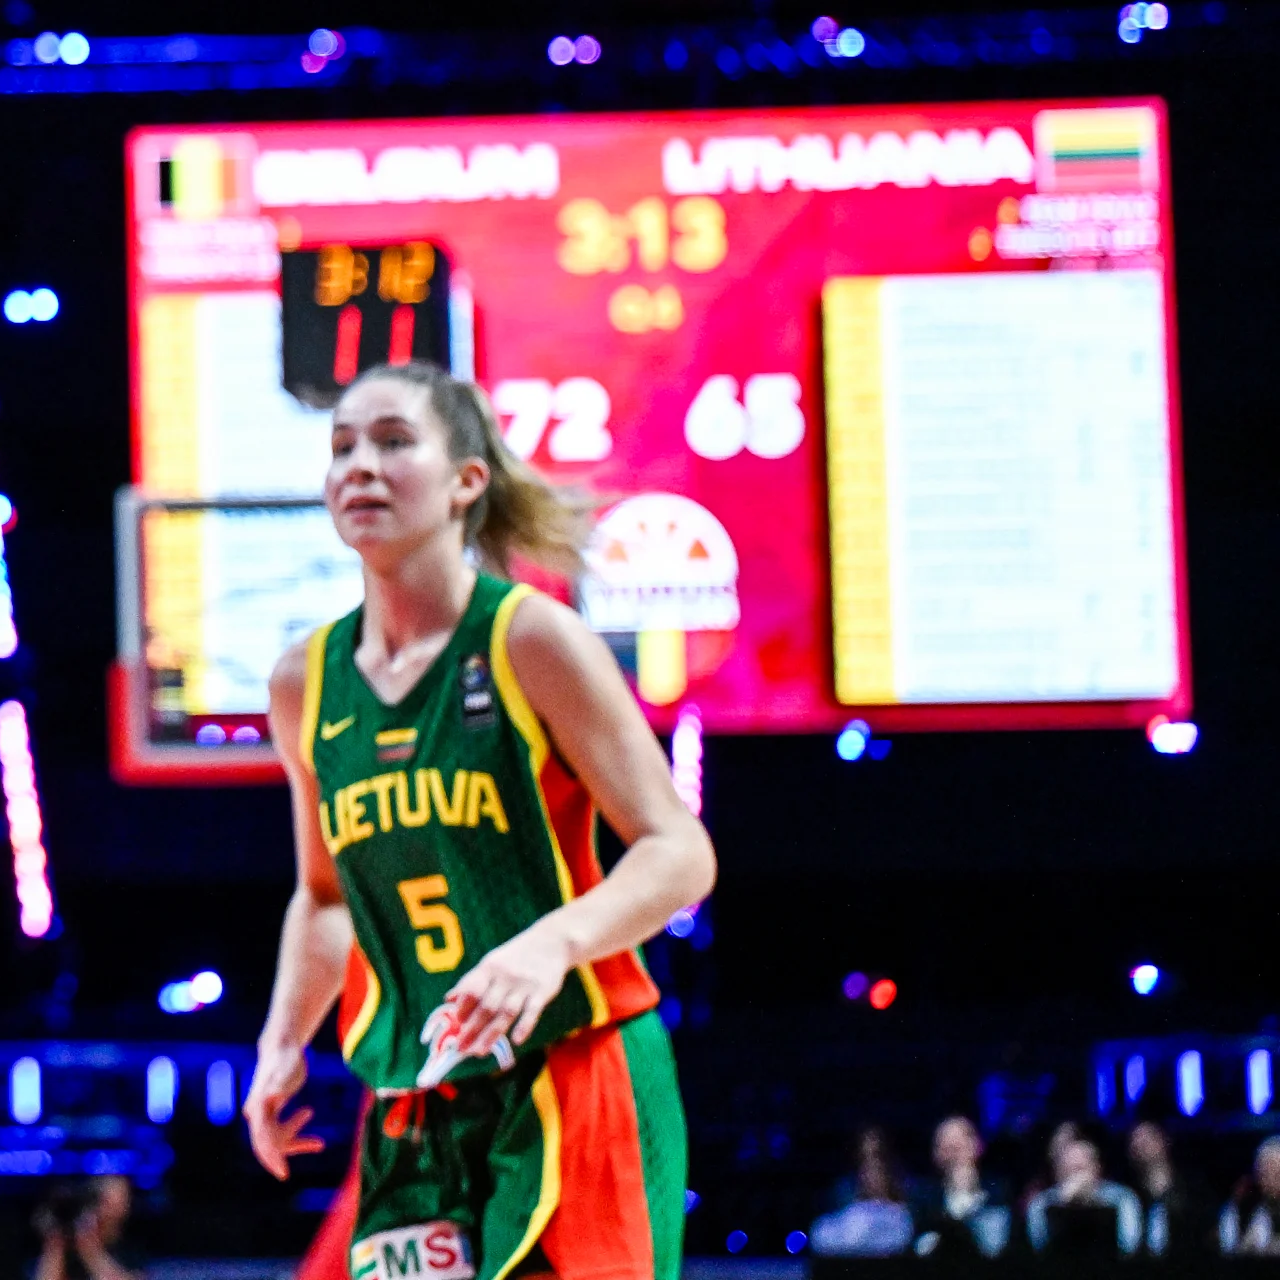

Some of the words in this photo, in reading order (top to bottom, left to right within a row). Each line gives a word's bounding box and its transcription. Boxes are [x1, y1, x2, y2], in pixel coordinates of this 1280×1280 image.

[557, 195, 728, 274] 3:13
[490, 376, 613, 462] 72
[683, 372, 807, 462] 65
[319, 767, 510, 856] LIETUVA
[397, 873, 466, 974] 5
